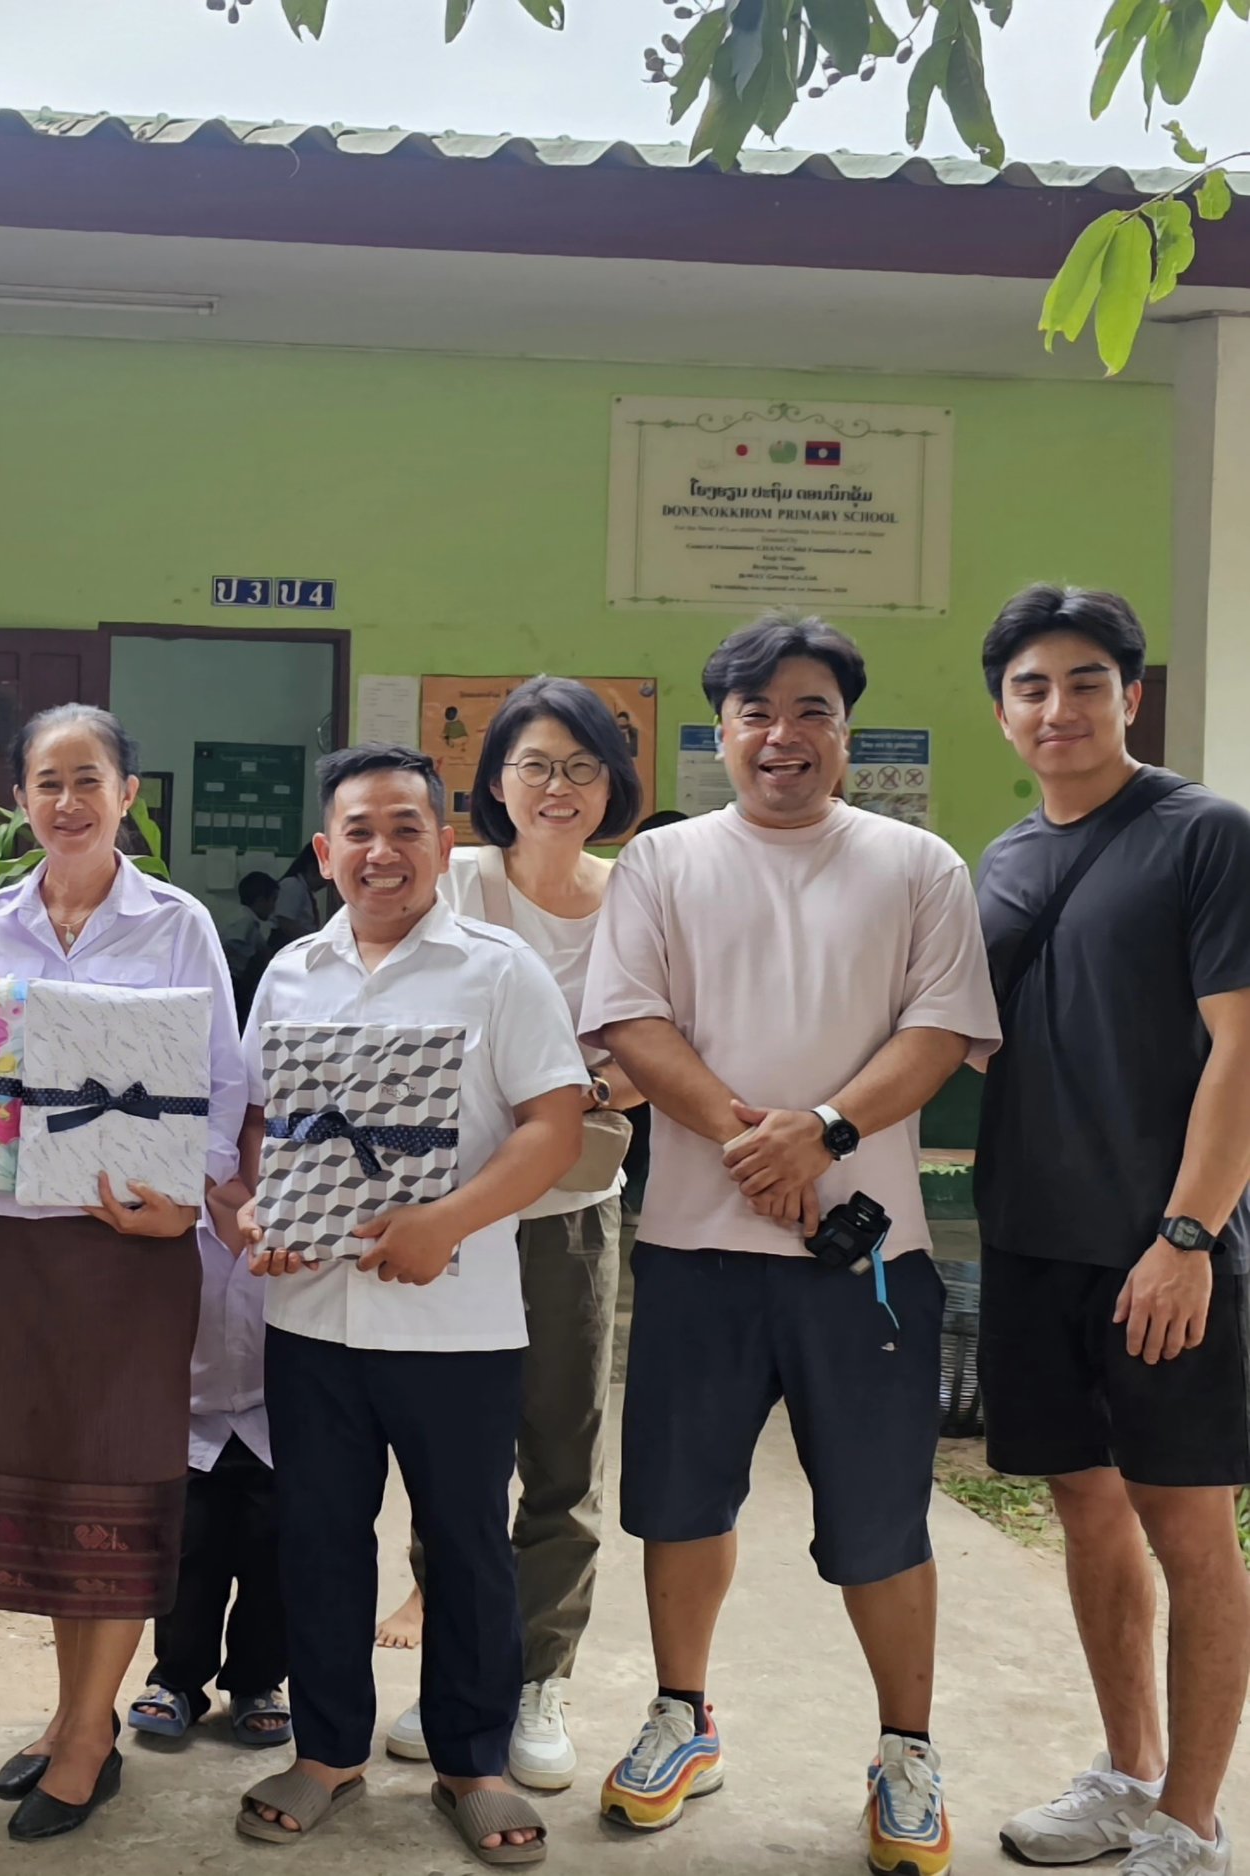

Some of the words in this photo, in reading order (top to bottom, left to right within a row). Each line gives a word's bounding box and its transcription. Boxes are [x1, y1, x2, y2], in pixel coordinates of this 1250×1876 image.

[662, 504, 773, 519] DONENOKKHOM
[777, 508, 839, 521] PRIMARY
[842, 511, 899, 523] SCHOOL
[247, 582, 263, 604] 3
[308, 584, 324, 606] 4
